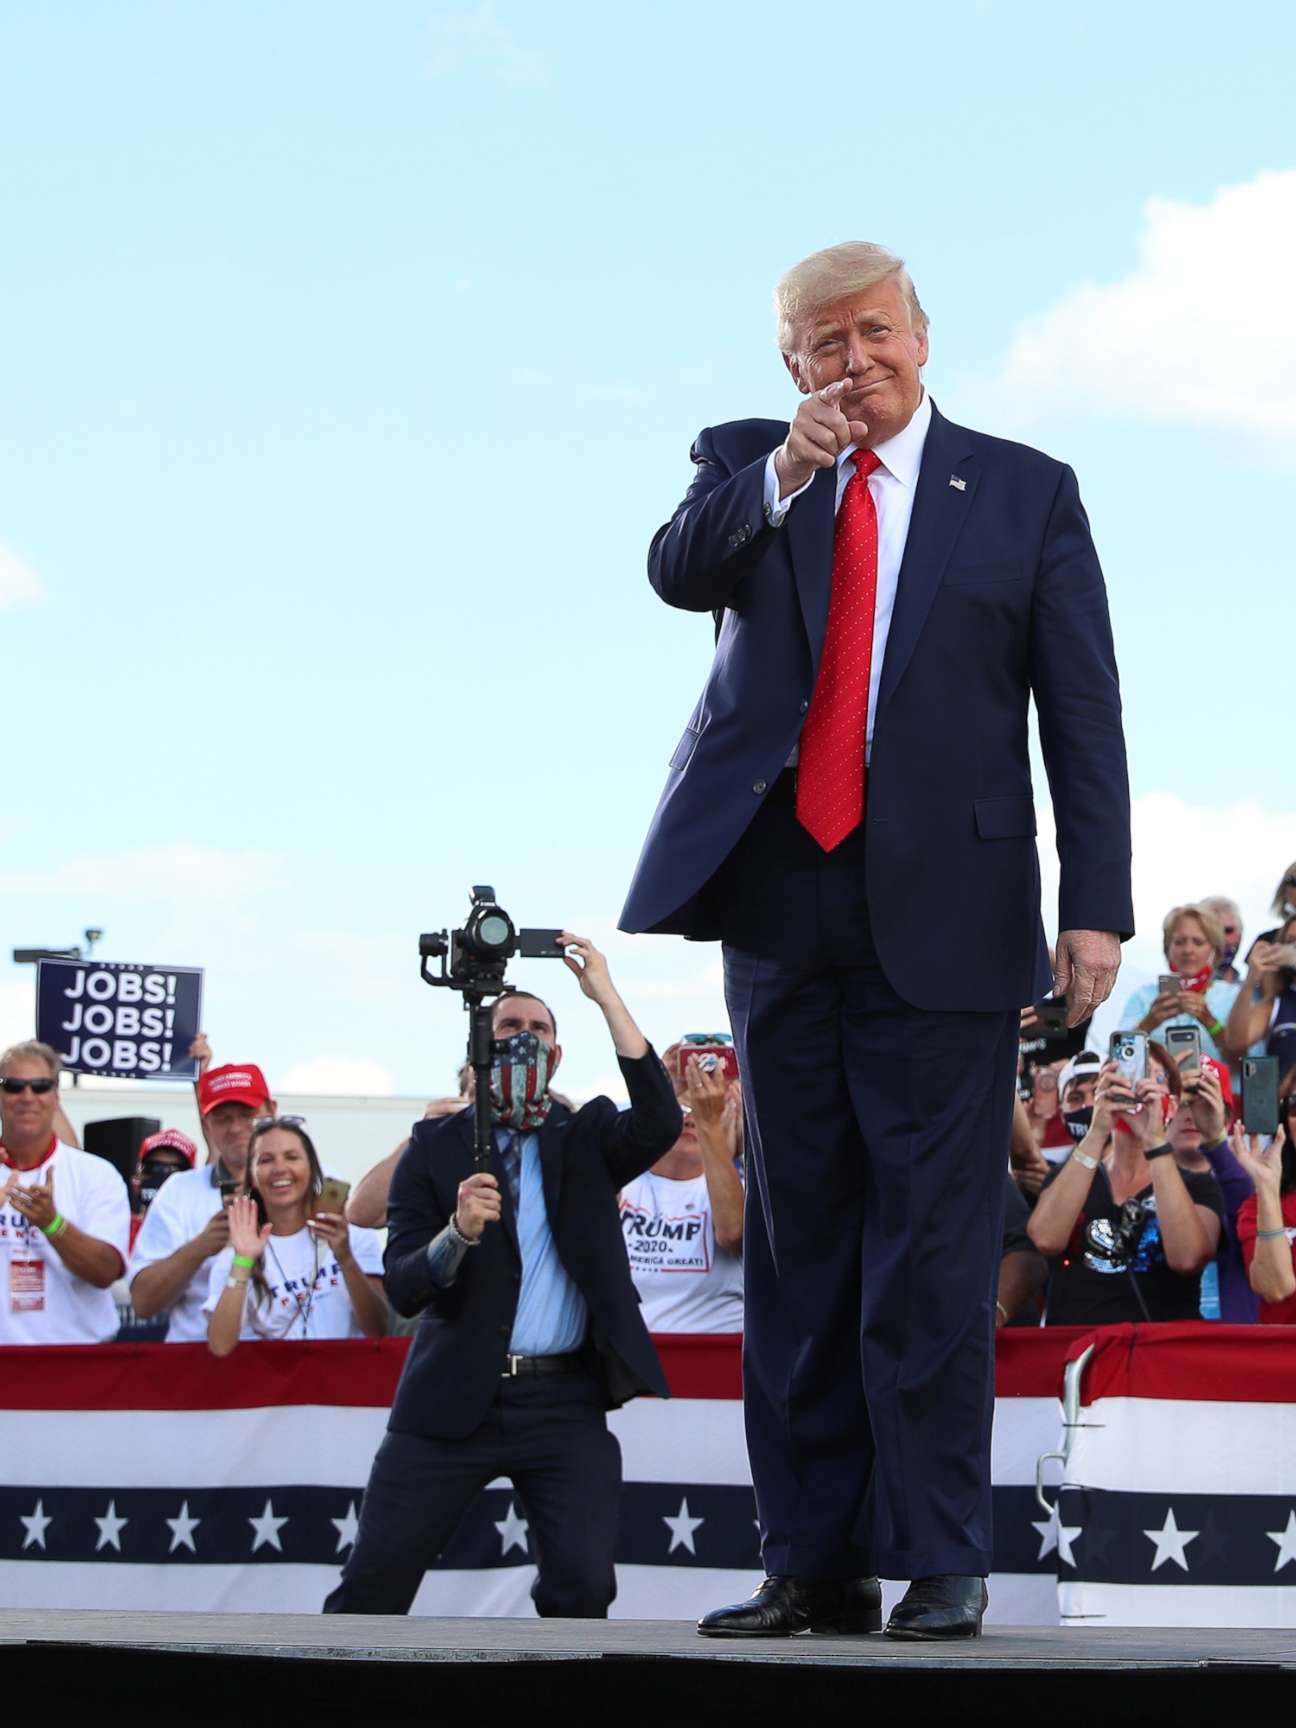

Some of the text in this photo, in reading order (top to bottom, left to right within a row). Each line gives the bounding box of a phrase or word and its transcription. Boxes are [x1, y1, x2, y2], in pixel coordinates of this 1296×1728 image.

[64, 970, 177, 1005] JOBS!
[62, 1003, 175, 1038] JOBS!
[60, 1036, 173, 1072] JOBS!
